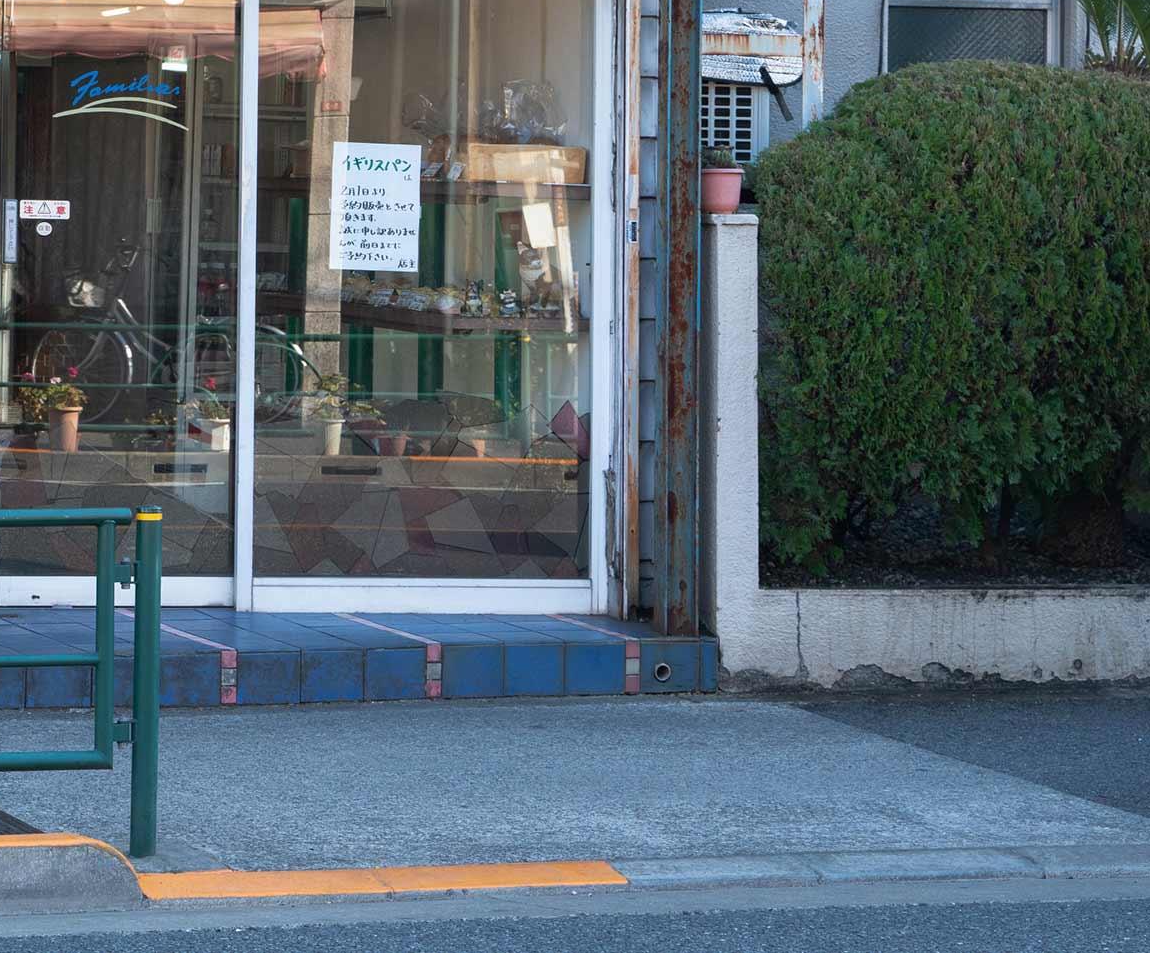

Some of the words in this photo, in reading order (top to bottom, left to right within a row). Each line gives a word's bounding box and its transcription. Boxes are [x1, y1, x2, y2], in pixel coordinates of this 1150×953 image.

[342, 155, 412, 172] イギリスパン
